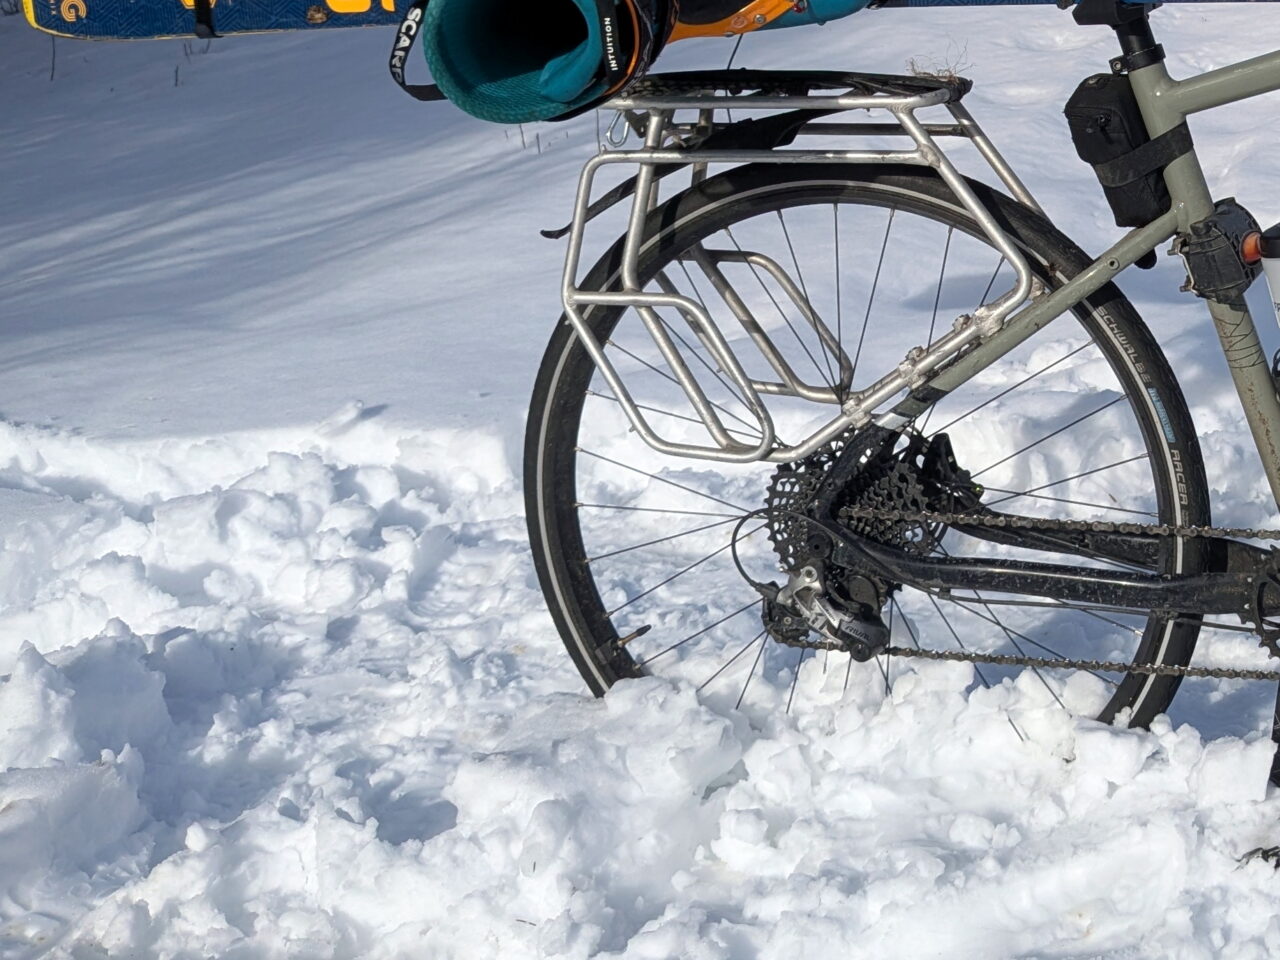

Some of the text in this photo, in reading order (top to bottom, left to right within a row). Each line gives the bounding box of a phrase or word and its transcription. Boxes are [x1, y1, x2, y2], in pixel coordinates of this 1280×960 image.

[603, 17, 620, 72] INTUITION
[1094, 305, 1153, 384] SCHWALBE
[1169, 448, 1190, 506] RACER
